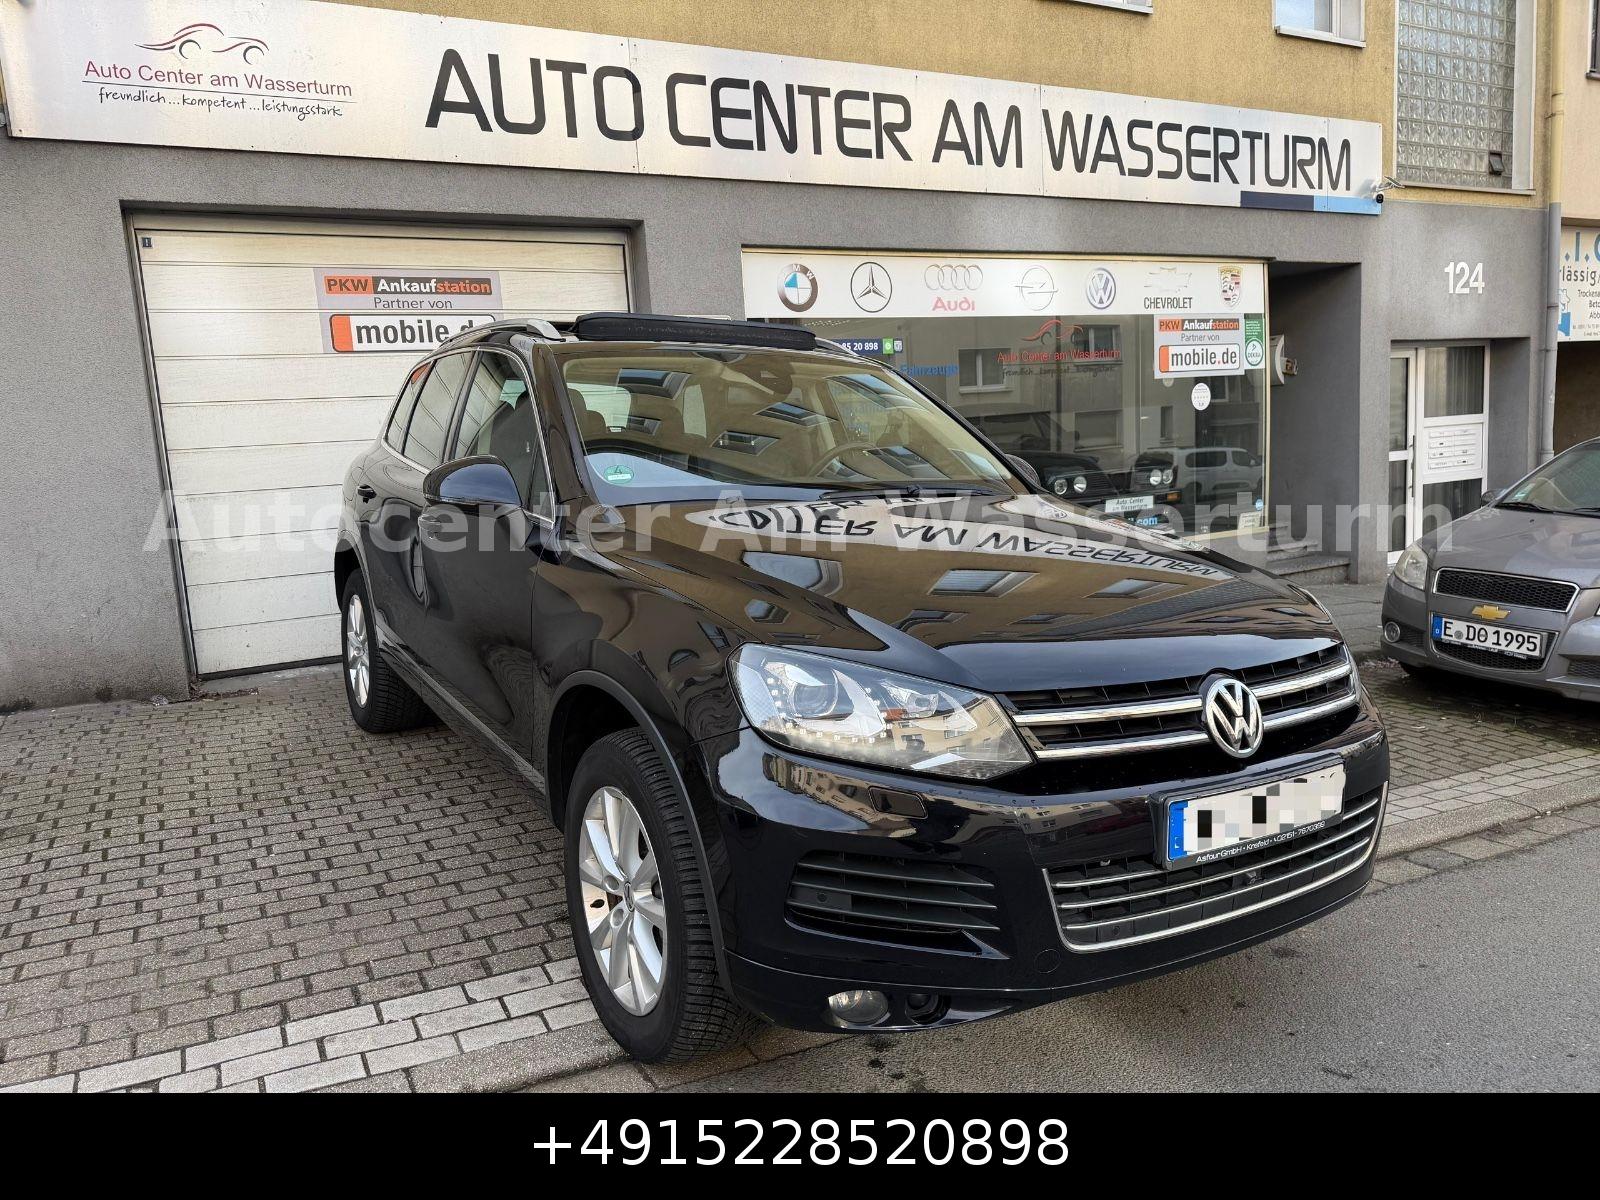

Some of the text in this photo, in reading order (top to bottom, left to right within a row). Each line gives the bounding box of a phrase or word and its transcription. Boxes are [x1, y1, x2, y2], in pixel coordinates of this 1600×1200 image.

[84, 61, 352, 97] Auto Center am Wasserturm
[424, 48, 1351, 191] AUTO CENTER AM WASSERTURM
[327, 278, 491, 294] PKW Ankaufstation
[1444, 261, 1486, 294] 124
[374, 297, 453, 310] Partner von
[932, 297, 975, 312] Audi
[1143, 296, 1193, 310] CHEVROLET
[356, 320, 475, 345] mobile
[1159, 320, 1181, 331] PKW
[1183, 319, 1239, 331] Ankaufstation
[1181, 333, 1206, 342] Partner
[853, 342, 863, 351] 20
[864, 342, 879, 351] 898
[1171, 348, 1237, 366] mobile.de
[1443, 621, 1453, 637] E
[1492, 629, 1538, 652] 1995
[1196, 851, 1221, 863] Asfour
[1220, 845, 1243, 857] GmbH
[1246, 840, 1270, 850] Krefeld
